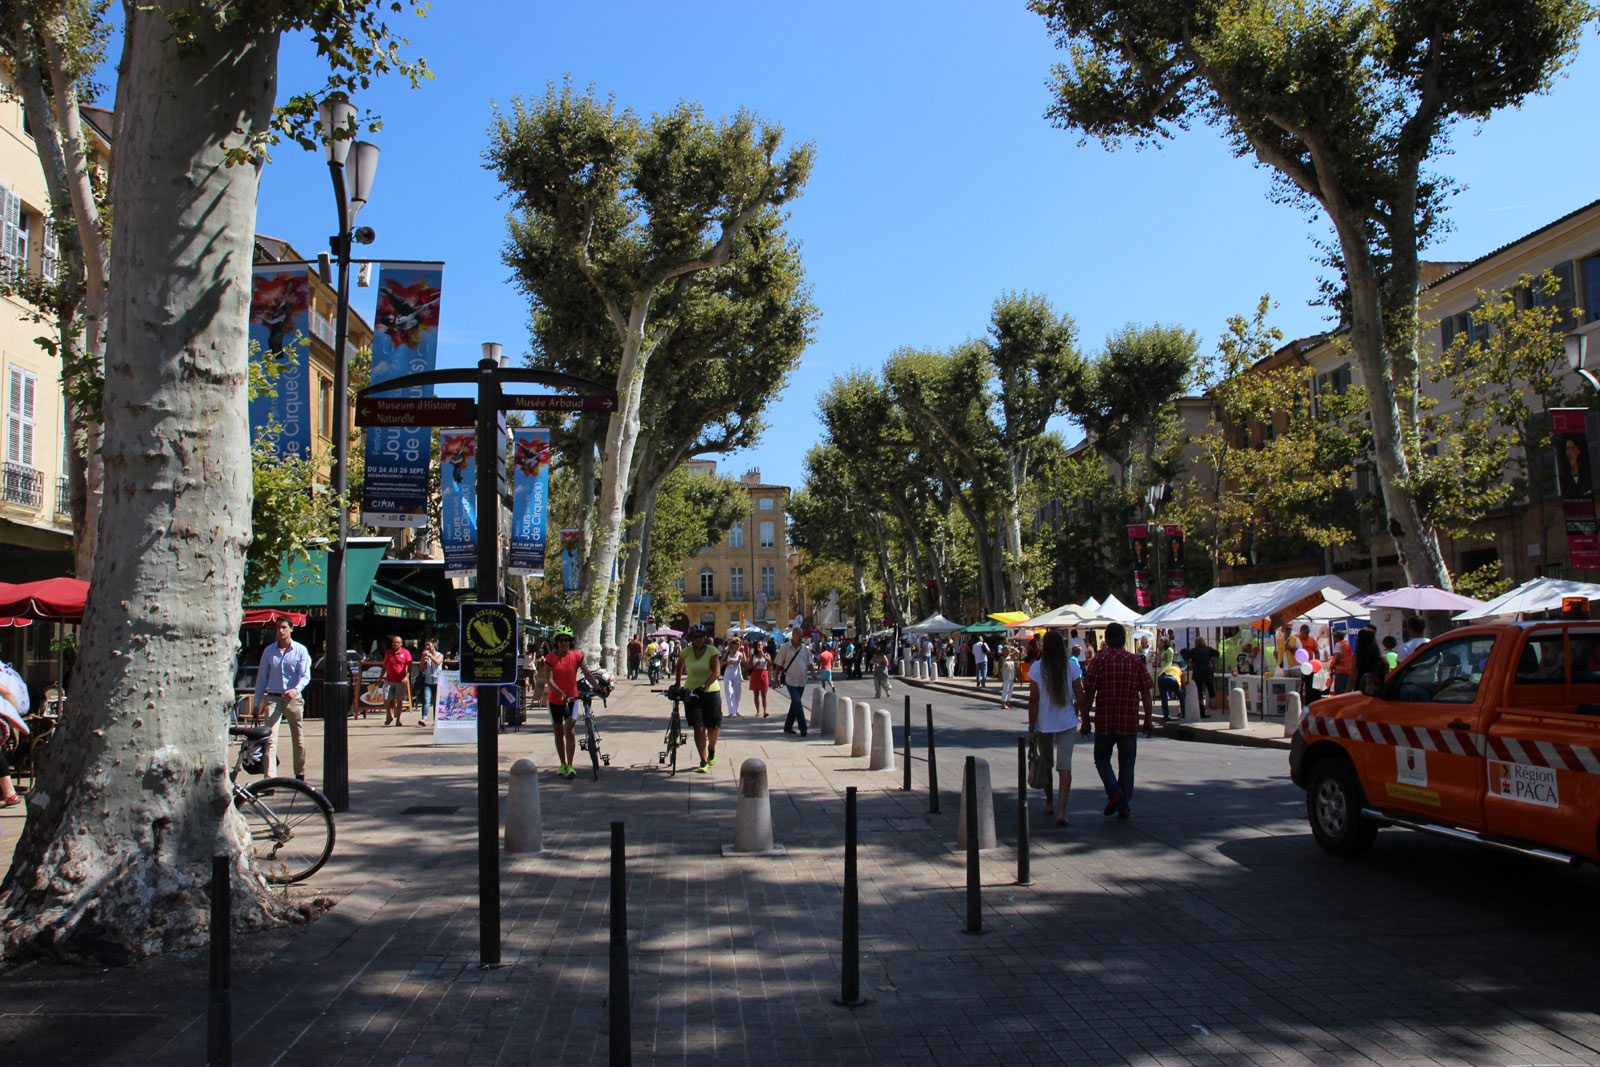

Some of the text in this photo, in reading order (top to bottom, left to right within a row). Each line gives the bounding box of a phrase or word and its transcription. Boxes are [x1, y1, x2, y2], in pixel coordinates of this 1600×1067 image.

[377, 400, 457, 410] Museum d'Histoire
[515, 397, 584, 408] Musée Arbaud
[377, 413, 415, 423] Naturelle
[372, 427, 382, 455] Festiva
[383, 427, 401, 461] Jou
[403, 438, 420, 462] de
[461, 484, 471, 542] de Cirque(s)
[531, 482, 544, 541] de Cirque(s)
[453, 516, 462, 542] Jours
[521, 514, 530, 540] Jours
[1515, 765, 1554, 784] Région
[1516, 781, 1557, 804] PACA
